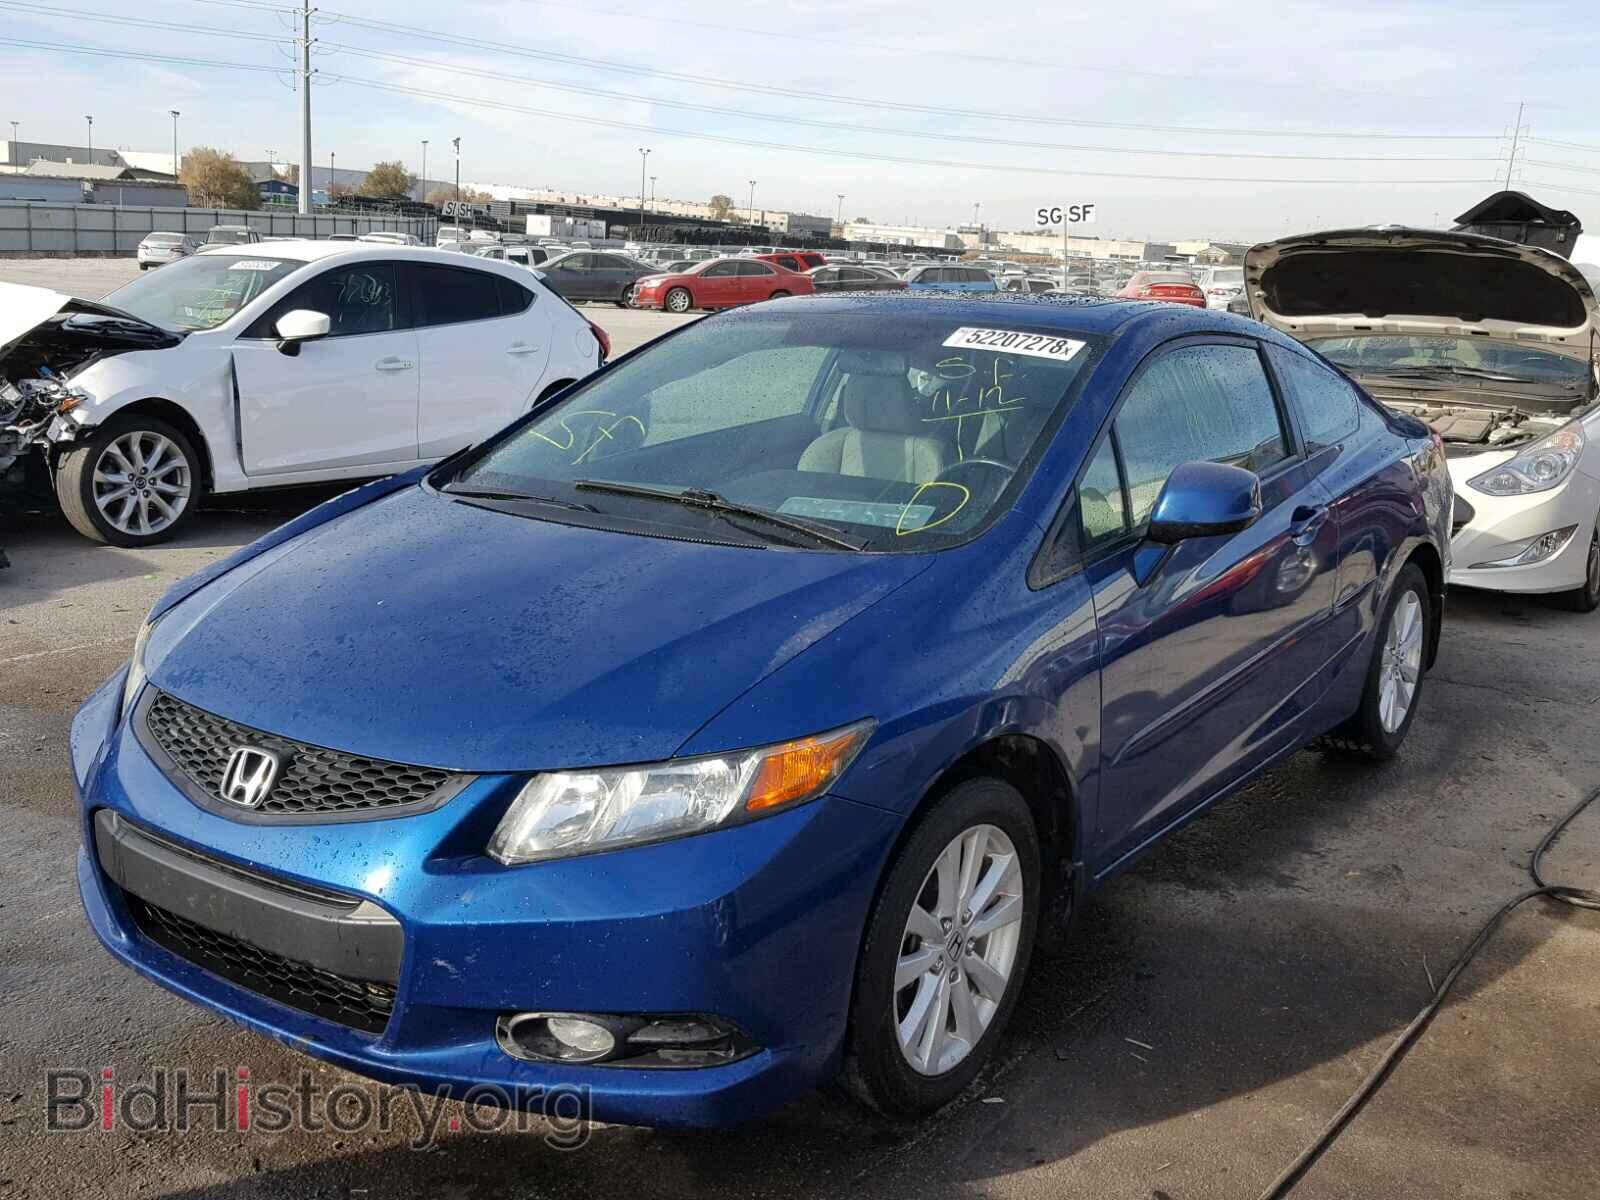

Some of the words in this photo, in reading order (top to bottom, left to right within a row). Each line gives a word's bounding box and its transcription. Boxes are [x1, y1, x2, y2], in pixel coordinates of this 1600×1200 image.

[459, 203, 472, 217] SH
[1037, 207, 1063, 226] SG
[1068, 204, 1095, 223] SF
